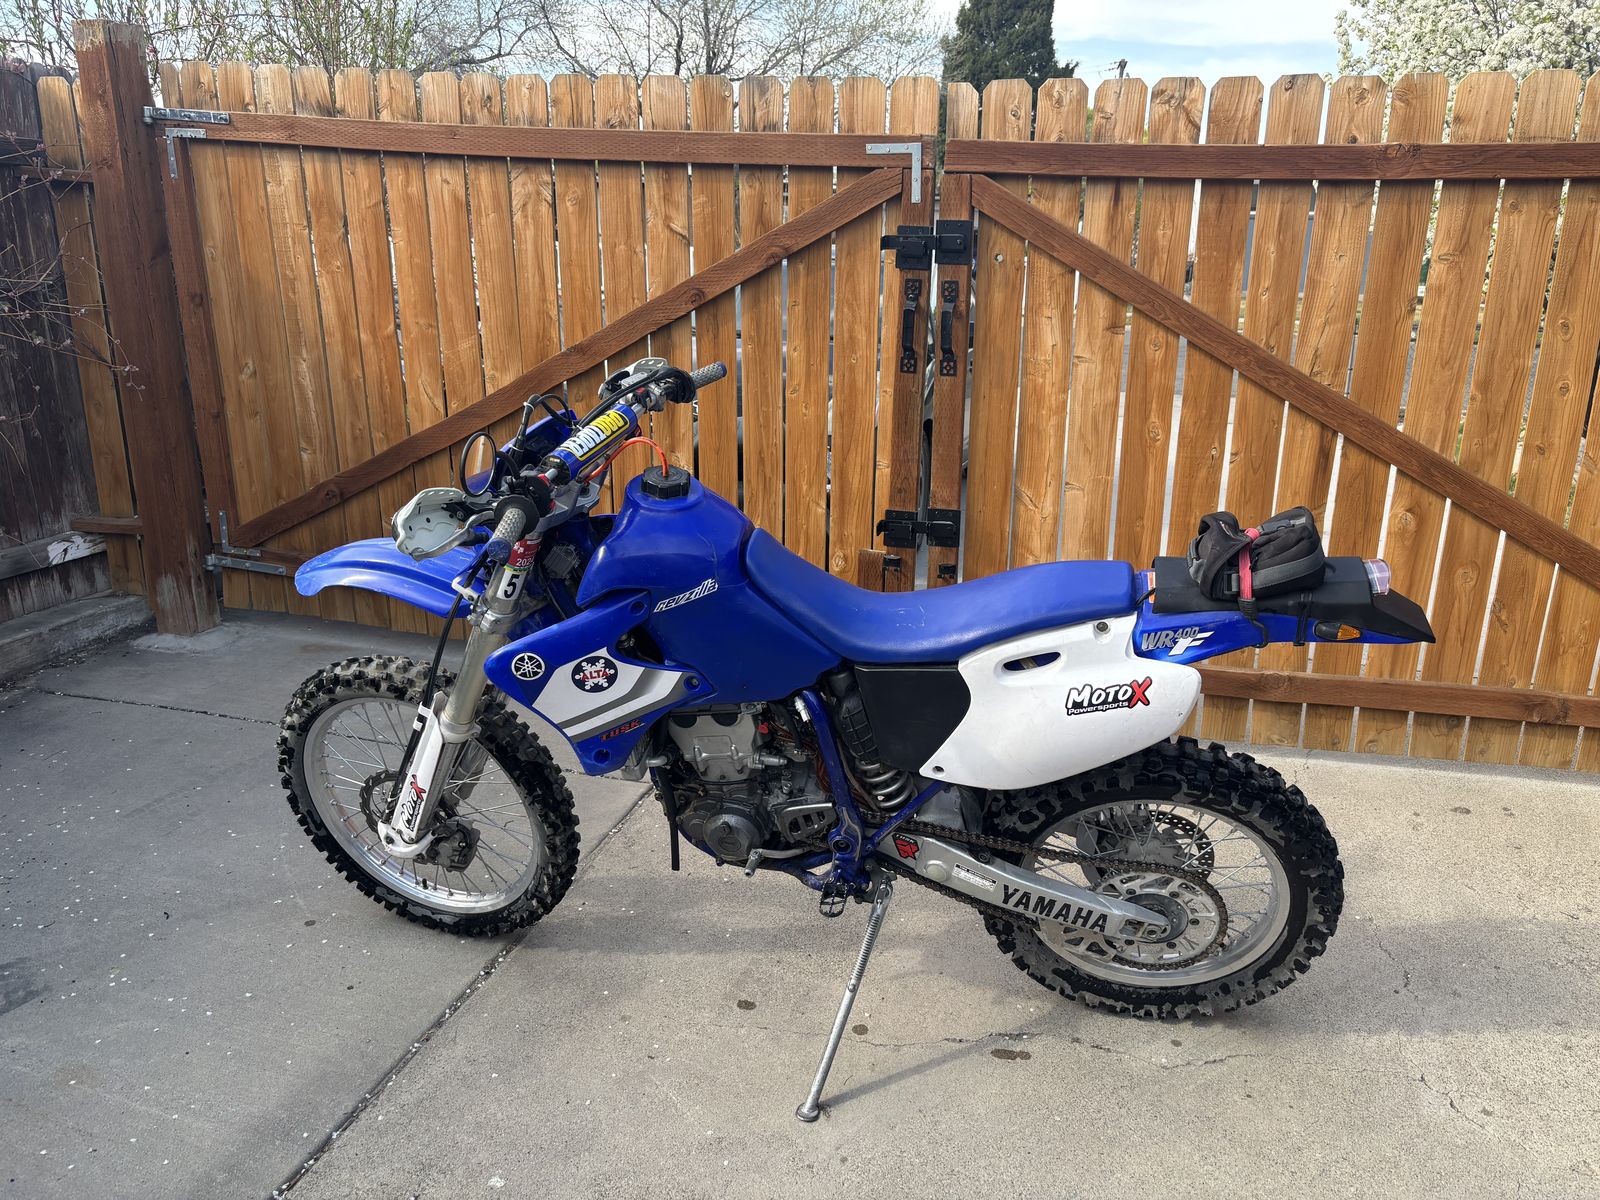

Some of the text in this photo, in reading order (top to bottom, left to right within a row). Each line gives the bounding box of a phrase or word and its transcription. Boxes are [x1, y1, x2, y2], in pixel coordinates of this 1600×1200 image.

[504, 574, 521, 599] 5
[654, 578, 718, 613] revzilla
[581, 669, 610, 682] ALTA
[1068, 700, 1129, 716] Powersports
[1001, 883, 1109, 934] YAMAHA
